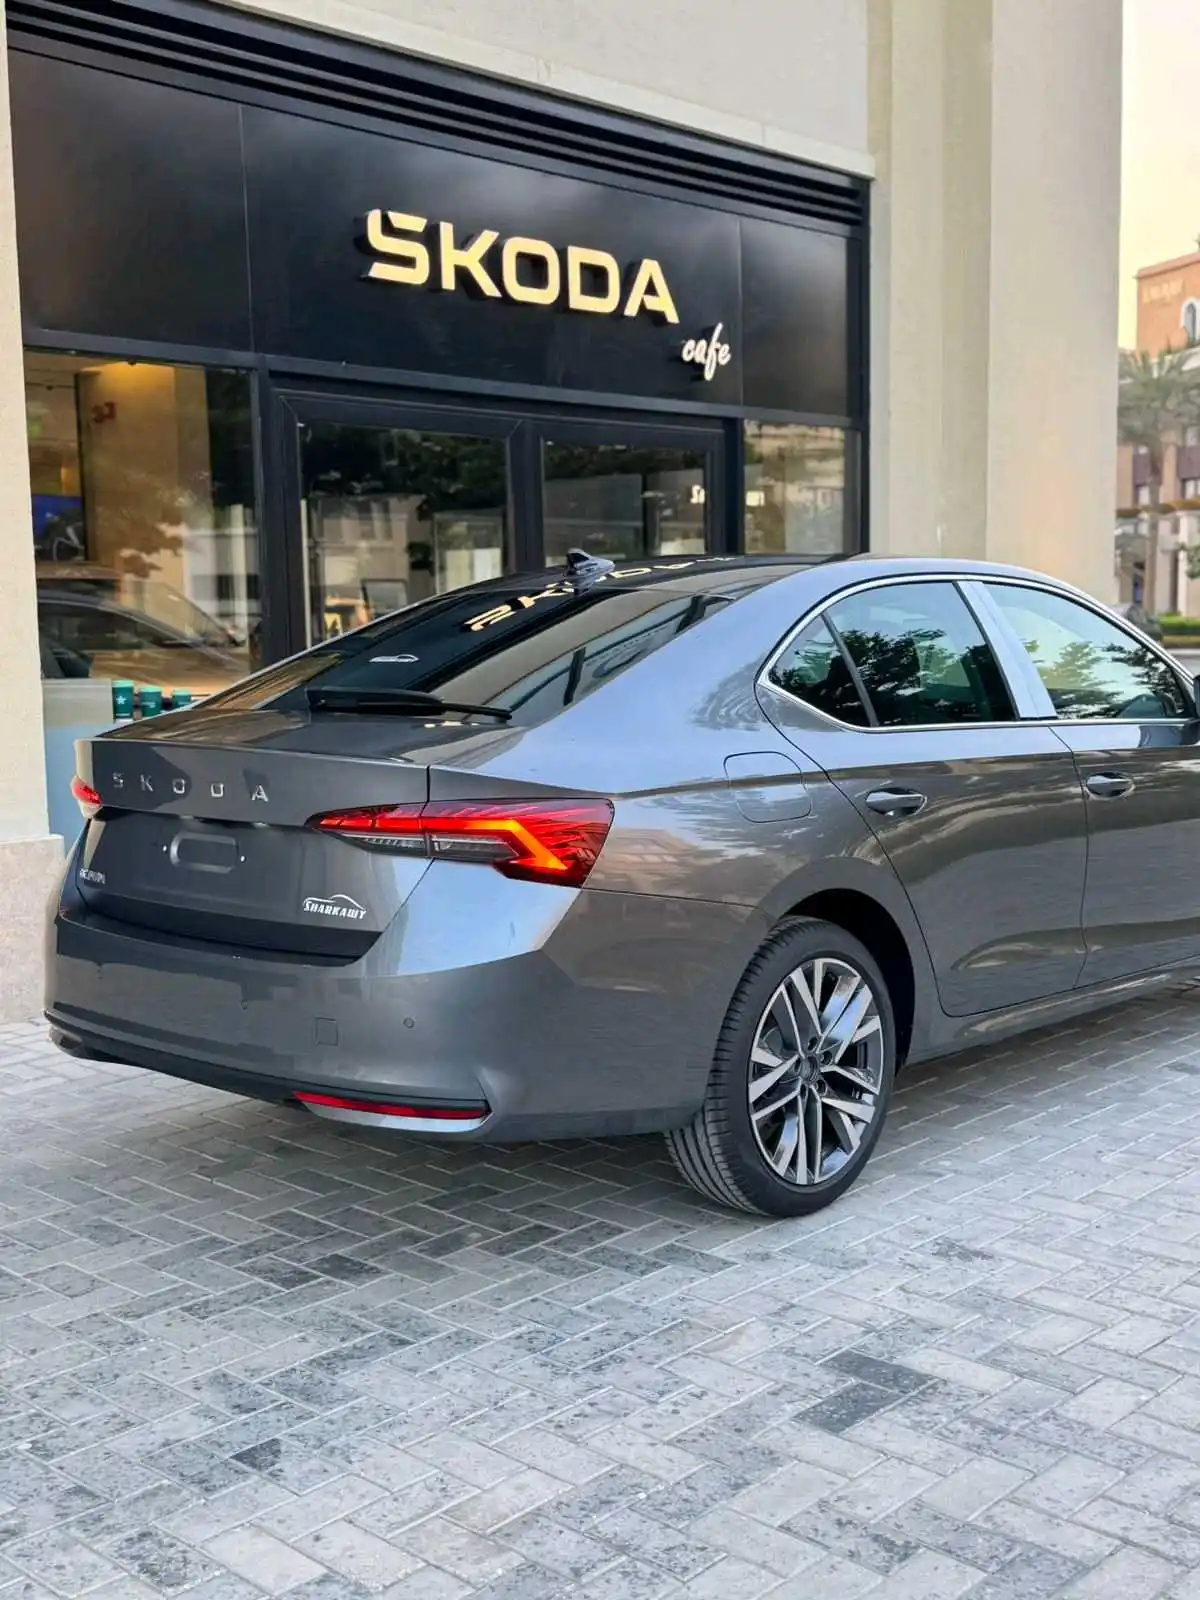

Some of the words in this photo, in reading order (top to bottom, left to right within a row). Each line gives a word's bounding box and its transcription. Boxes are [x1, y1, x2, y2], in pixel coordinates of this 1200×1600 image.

[367, 208, 680, 325] SKODA
[681, 322, 732, 381] cafe
[112, 771, 270, 803] SKODA
